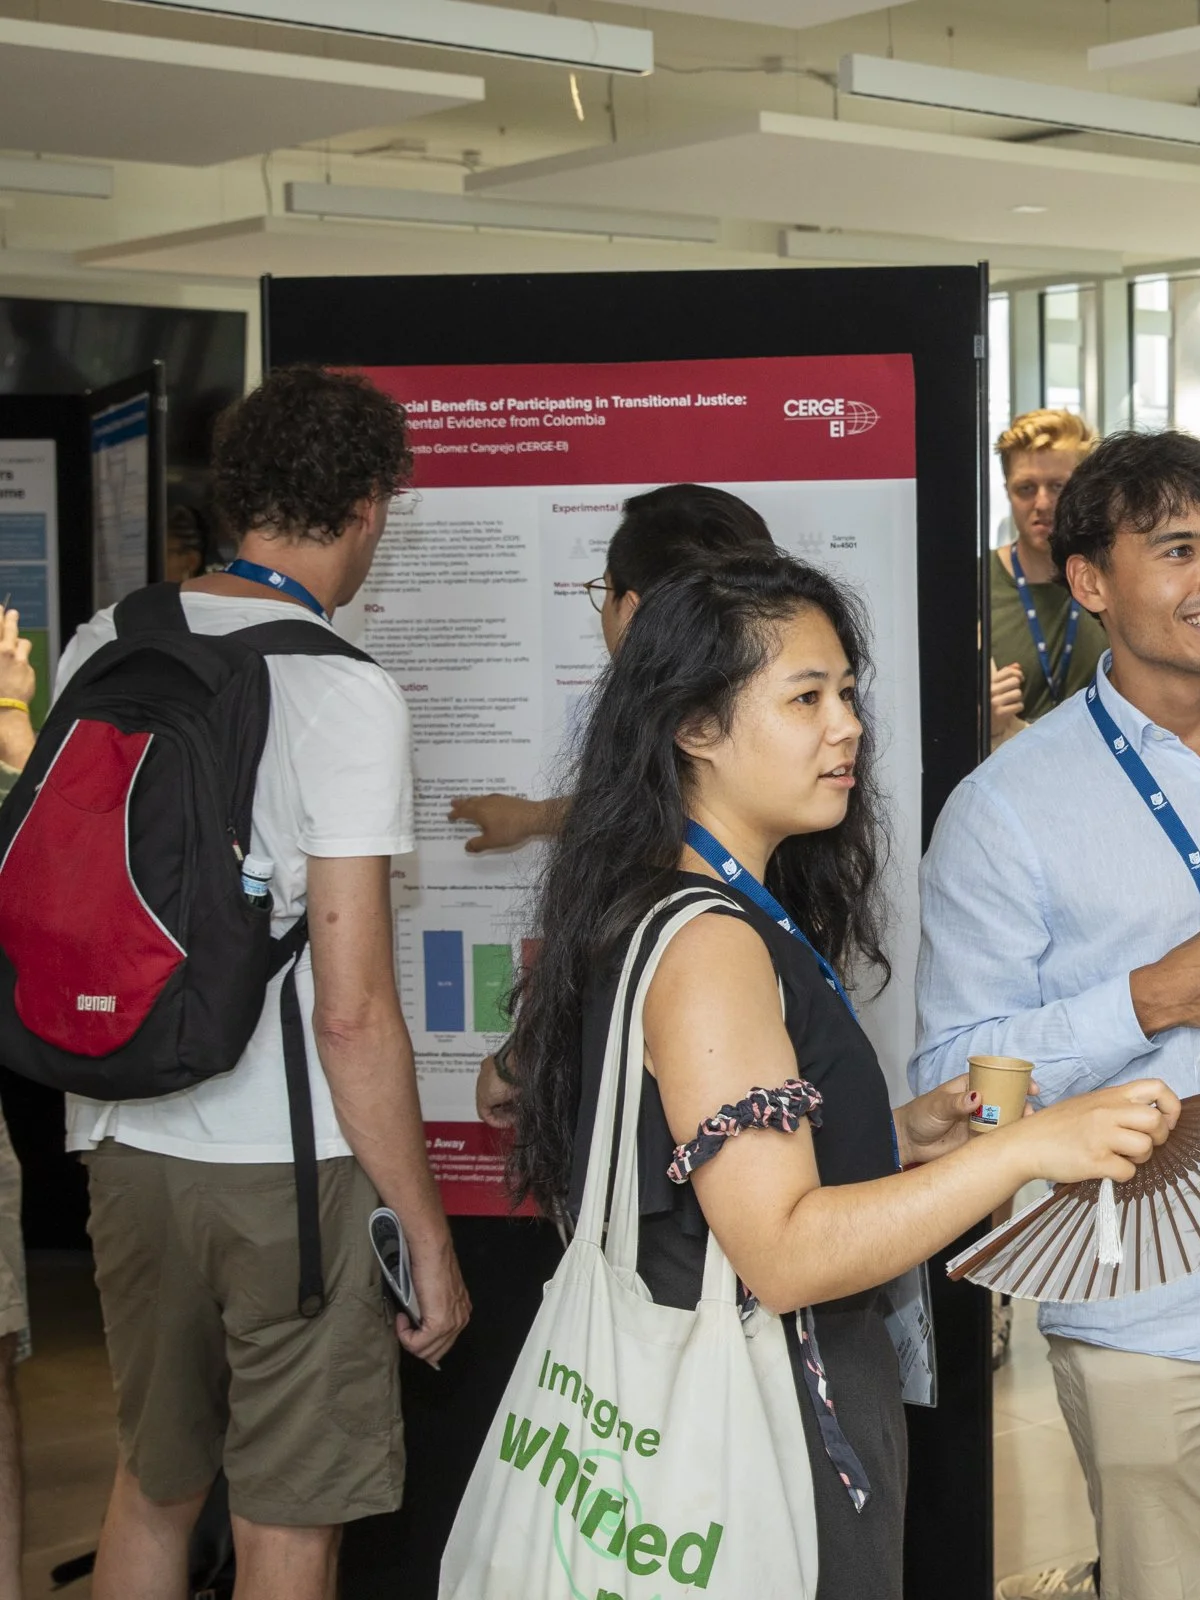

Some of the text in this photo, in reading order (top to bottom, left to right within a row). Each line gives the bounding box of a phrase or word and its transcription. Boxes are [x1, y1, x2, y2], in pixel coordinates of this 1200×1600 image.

[403, 393, 747, 413] cial Benefits of Participating in Transitional Justice:
[783, 398, 845, 417] CERGE
[447, 415, 507, 429] Evidence
[510, 414, 540, 428] from
[543, 414, 605, 427] Colombia
[830, 420, 844, 438] EI
[434, 443, 468, 454] Gomez
[470, 442, 516, 456] Cangrejo
[517, 441, 569, 454] (CERGE-EI)
[552, 503, 619, 514] Experimental
[364, 604, 385, 614] RQs
[77, 994, 116, 1013] denali
[434, 1137, 466, 1151] Away
[538, 1350, 661, 1457] Imagne
